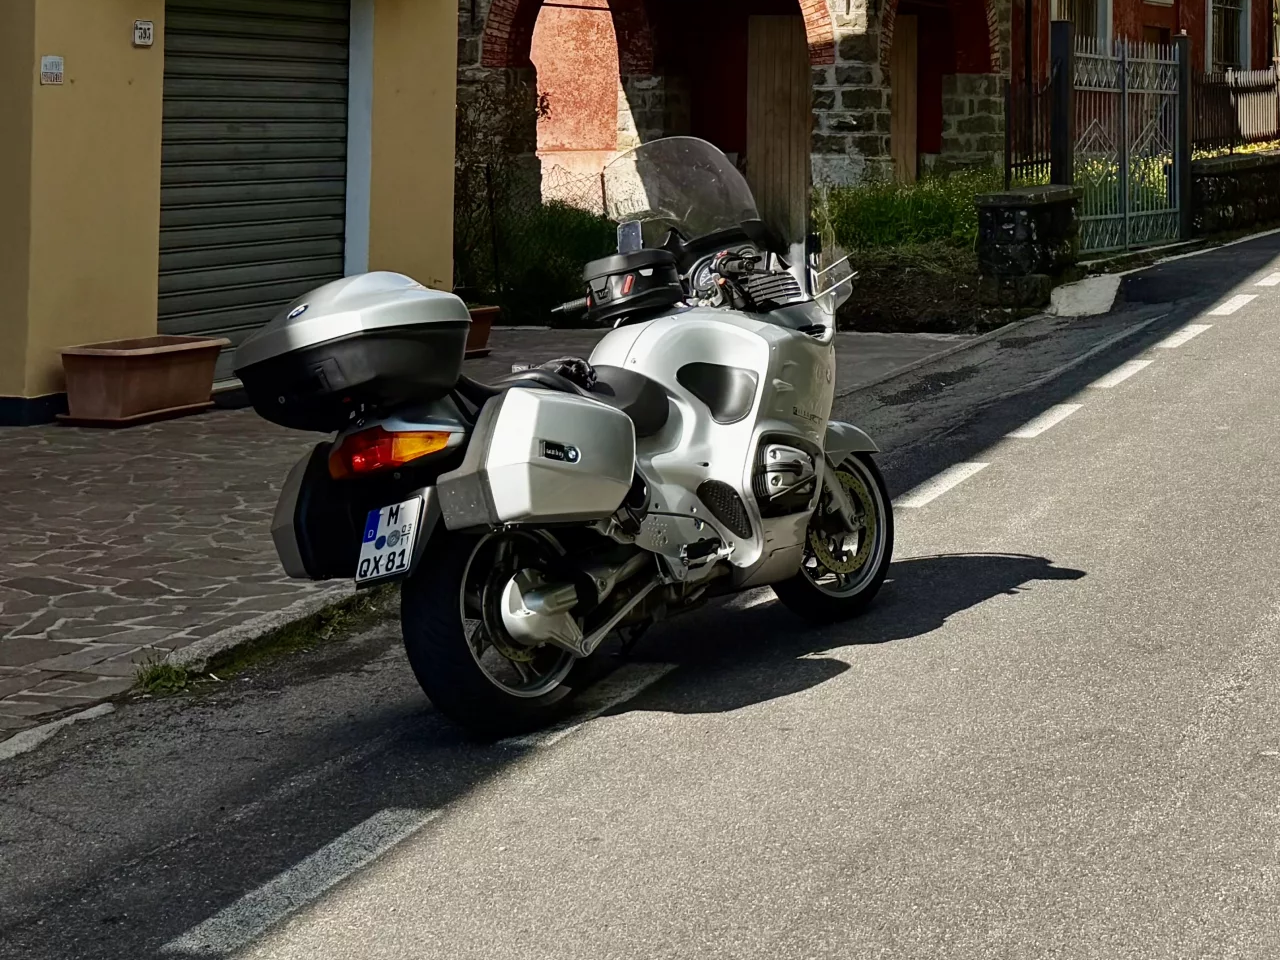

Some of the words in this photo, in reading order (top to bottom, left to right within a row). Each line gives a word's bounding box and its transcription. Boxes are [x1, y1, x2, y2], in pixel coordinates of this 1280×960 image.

[387, 504, 400, 527] M
[368, 529, 374, 538] D
[358, 554, 383, 578] QX
[385, 548, 406, 572] 81
